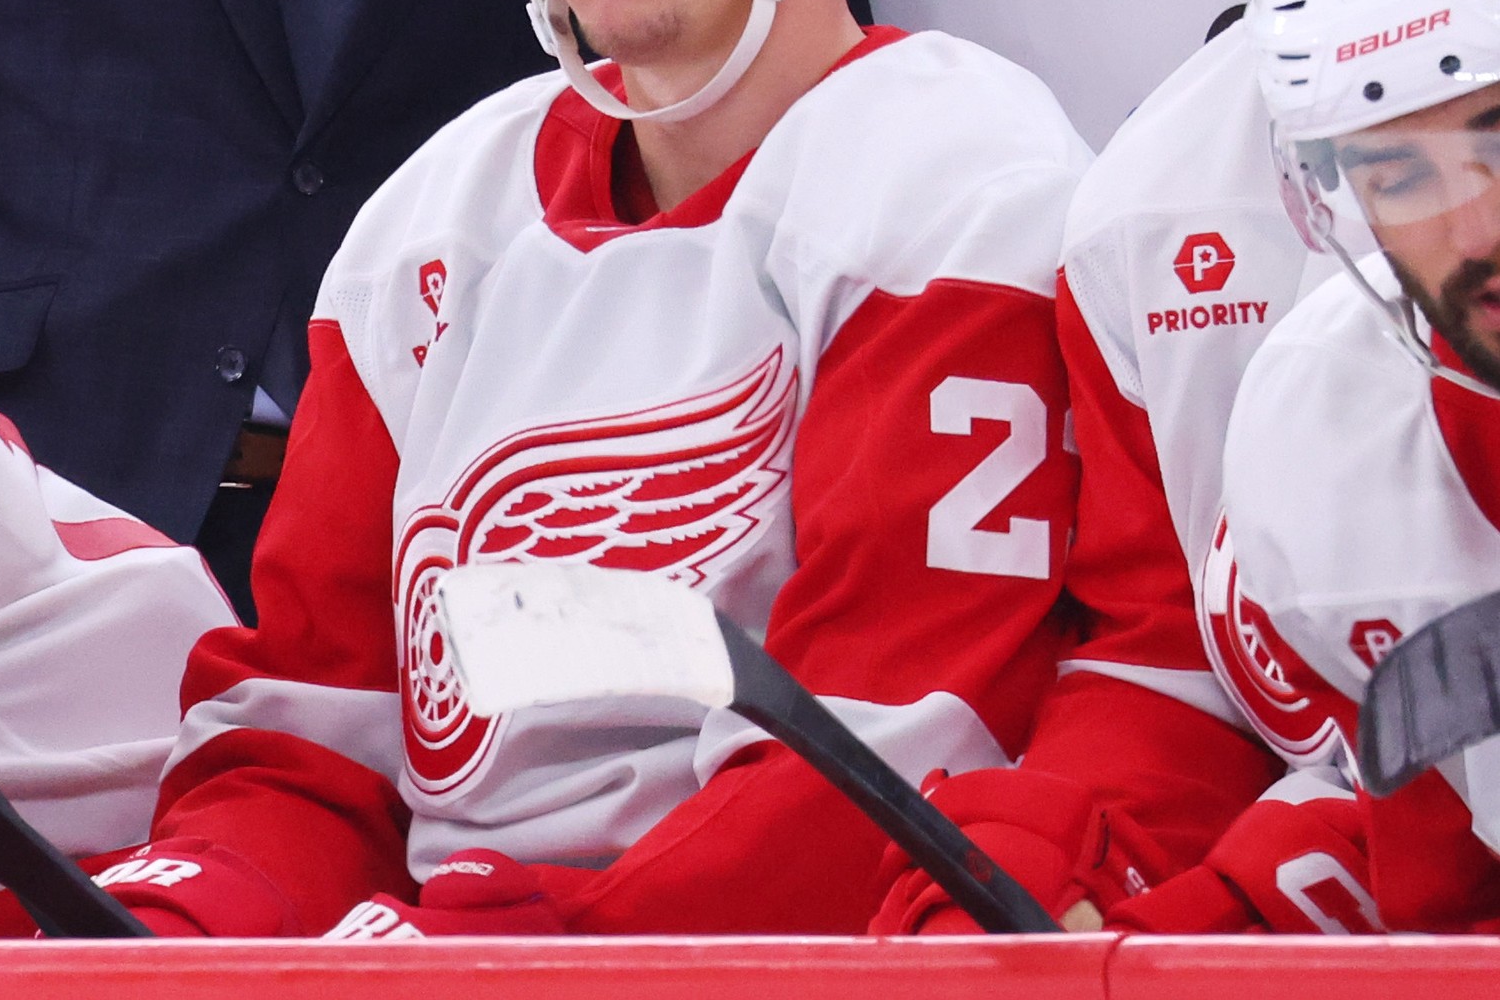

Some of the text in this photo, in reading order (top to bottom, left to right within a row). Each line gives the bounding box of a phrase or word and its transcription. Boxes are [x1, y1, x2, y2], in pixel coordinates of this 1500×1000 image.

[1335, 7, 1452, 63] BAUER
[1146, 301, 1269, 335] PRIORITY
[925, 375, 1082, 580] 2
